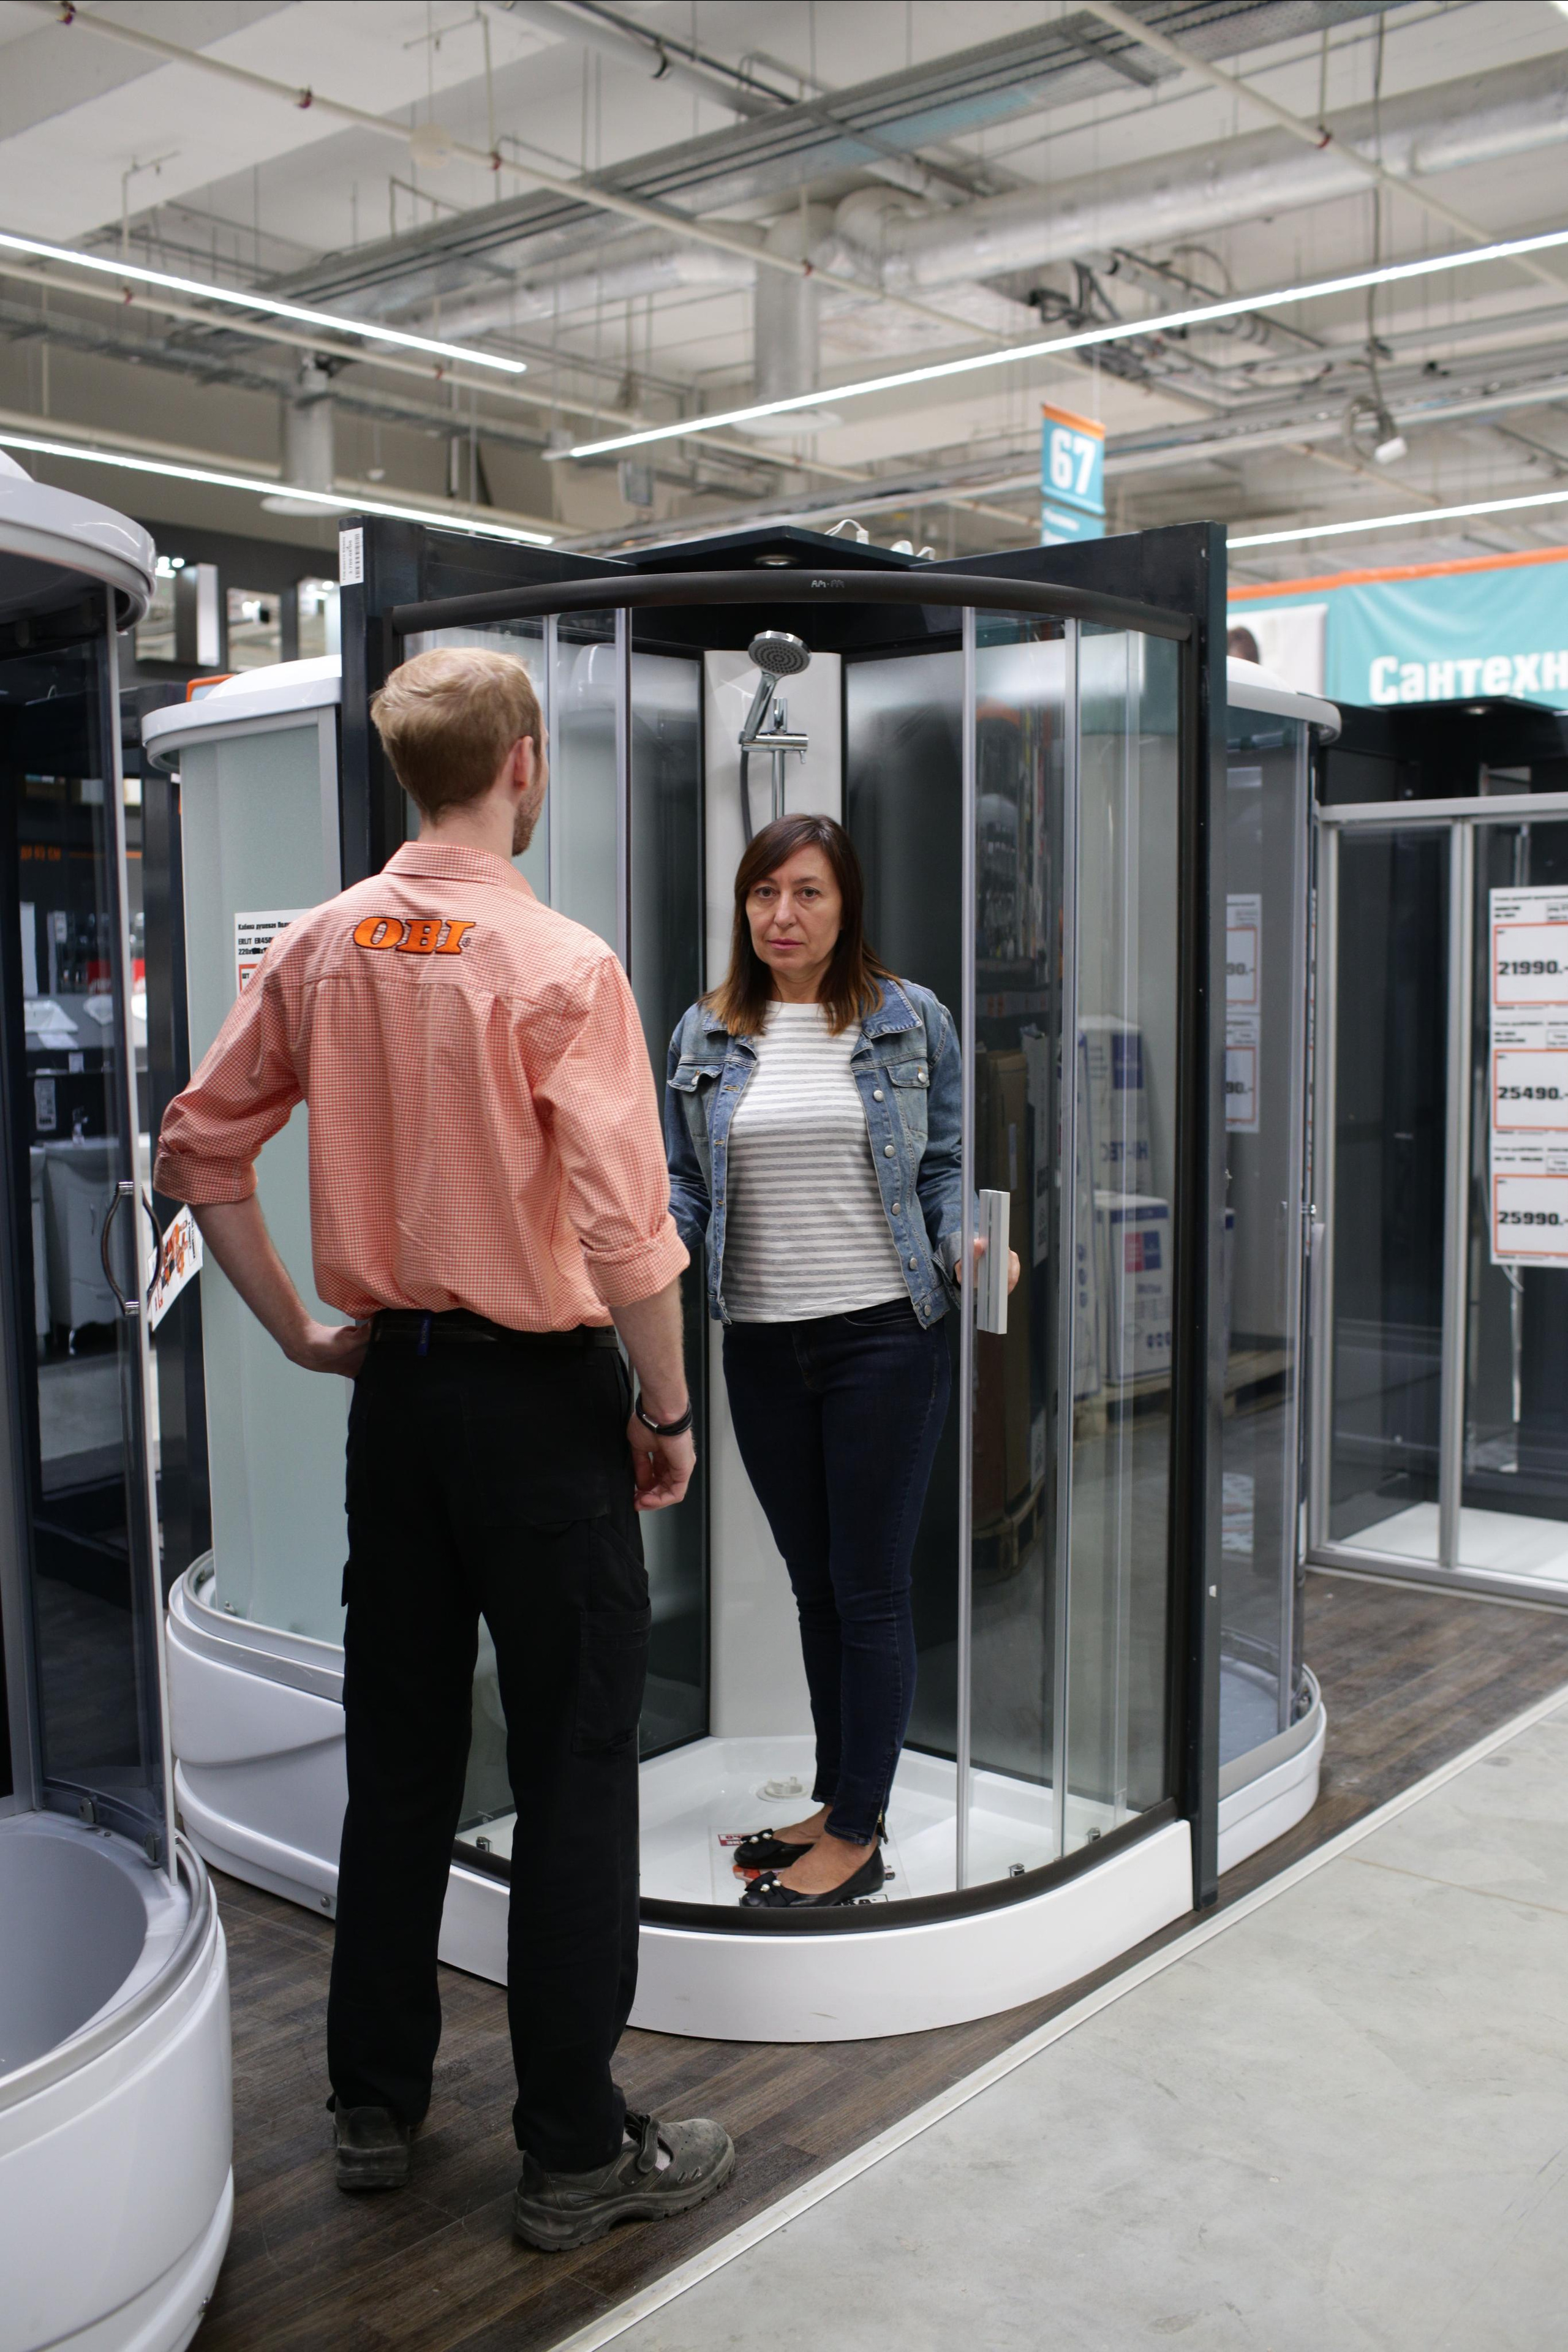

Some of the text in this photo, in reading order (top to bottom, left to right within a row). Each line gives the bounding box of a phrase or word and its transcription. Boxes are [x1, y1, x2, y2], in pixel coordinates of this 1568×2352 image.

[1050, 428, 1096, 496] 67
[1369, 649, 1568, 705] Сантехн
[353, 916, 477, 954] OBI
